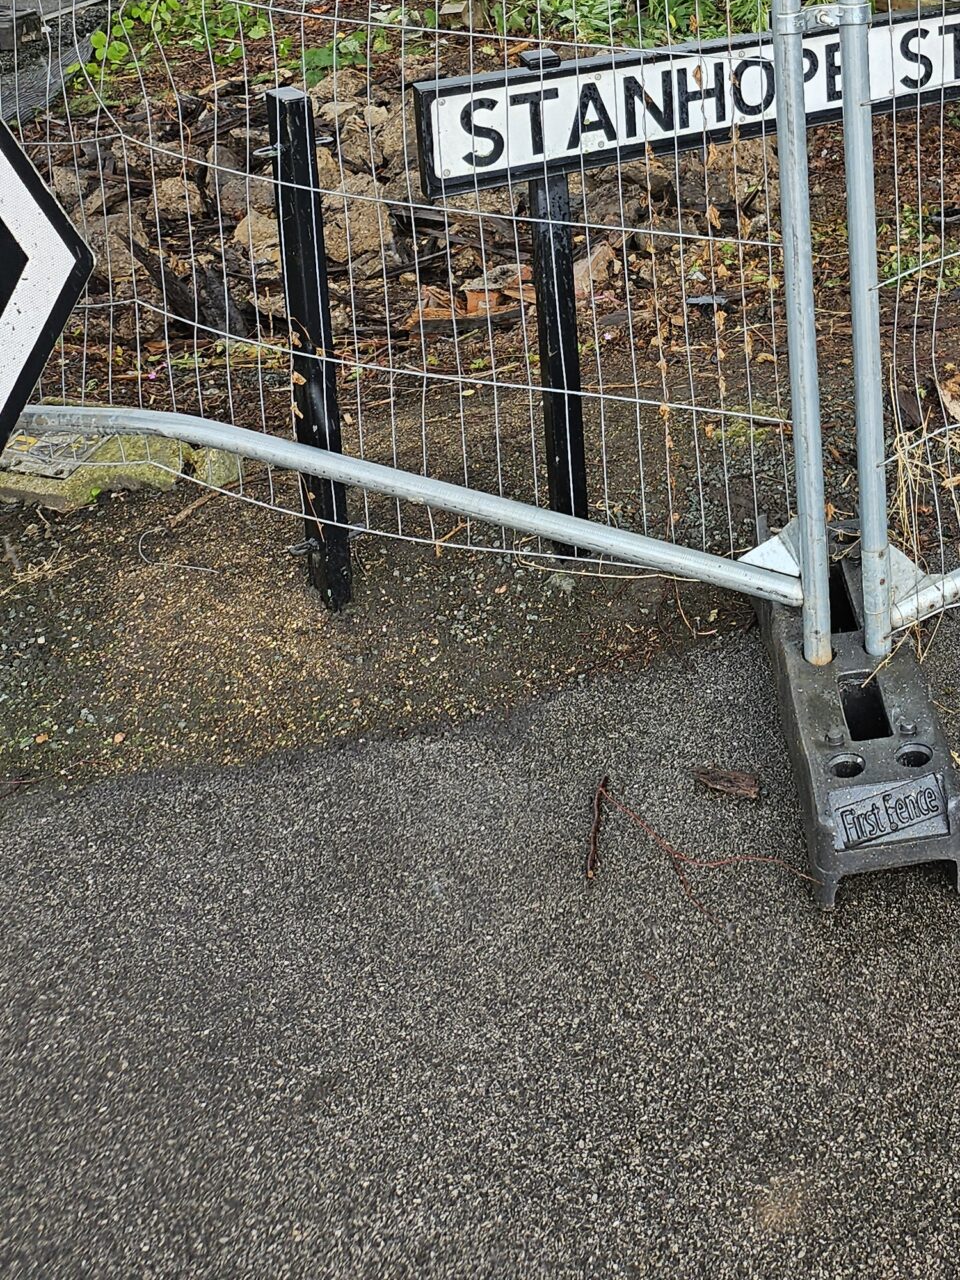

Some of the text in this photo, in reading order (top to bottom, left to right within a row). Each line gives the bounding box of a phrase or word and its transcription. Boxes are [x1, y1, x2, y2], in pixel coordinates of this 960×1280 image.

[459, 41, 843, 168] STANHOPE
[840, 786, 940, 843] First Fence
